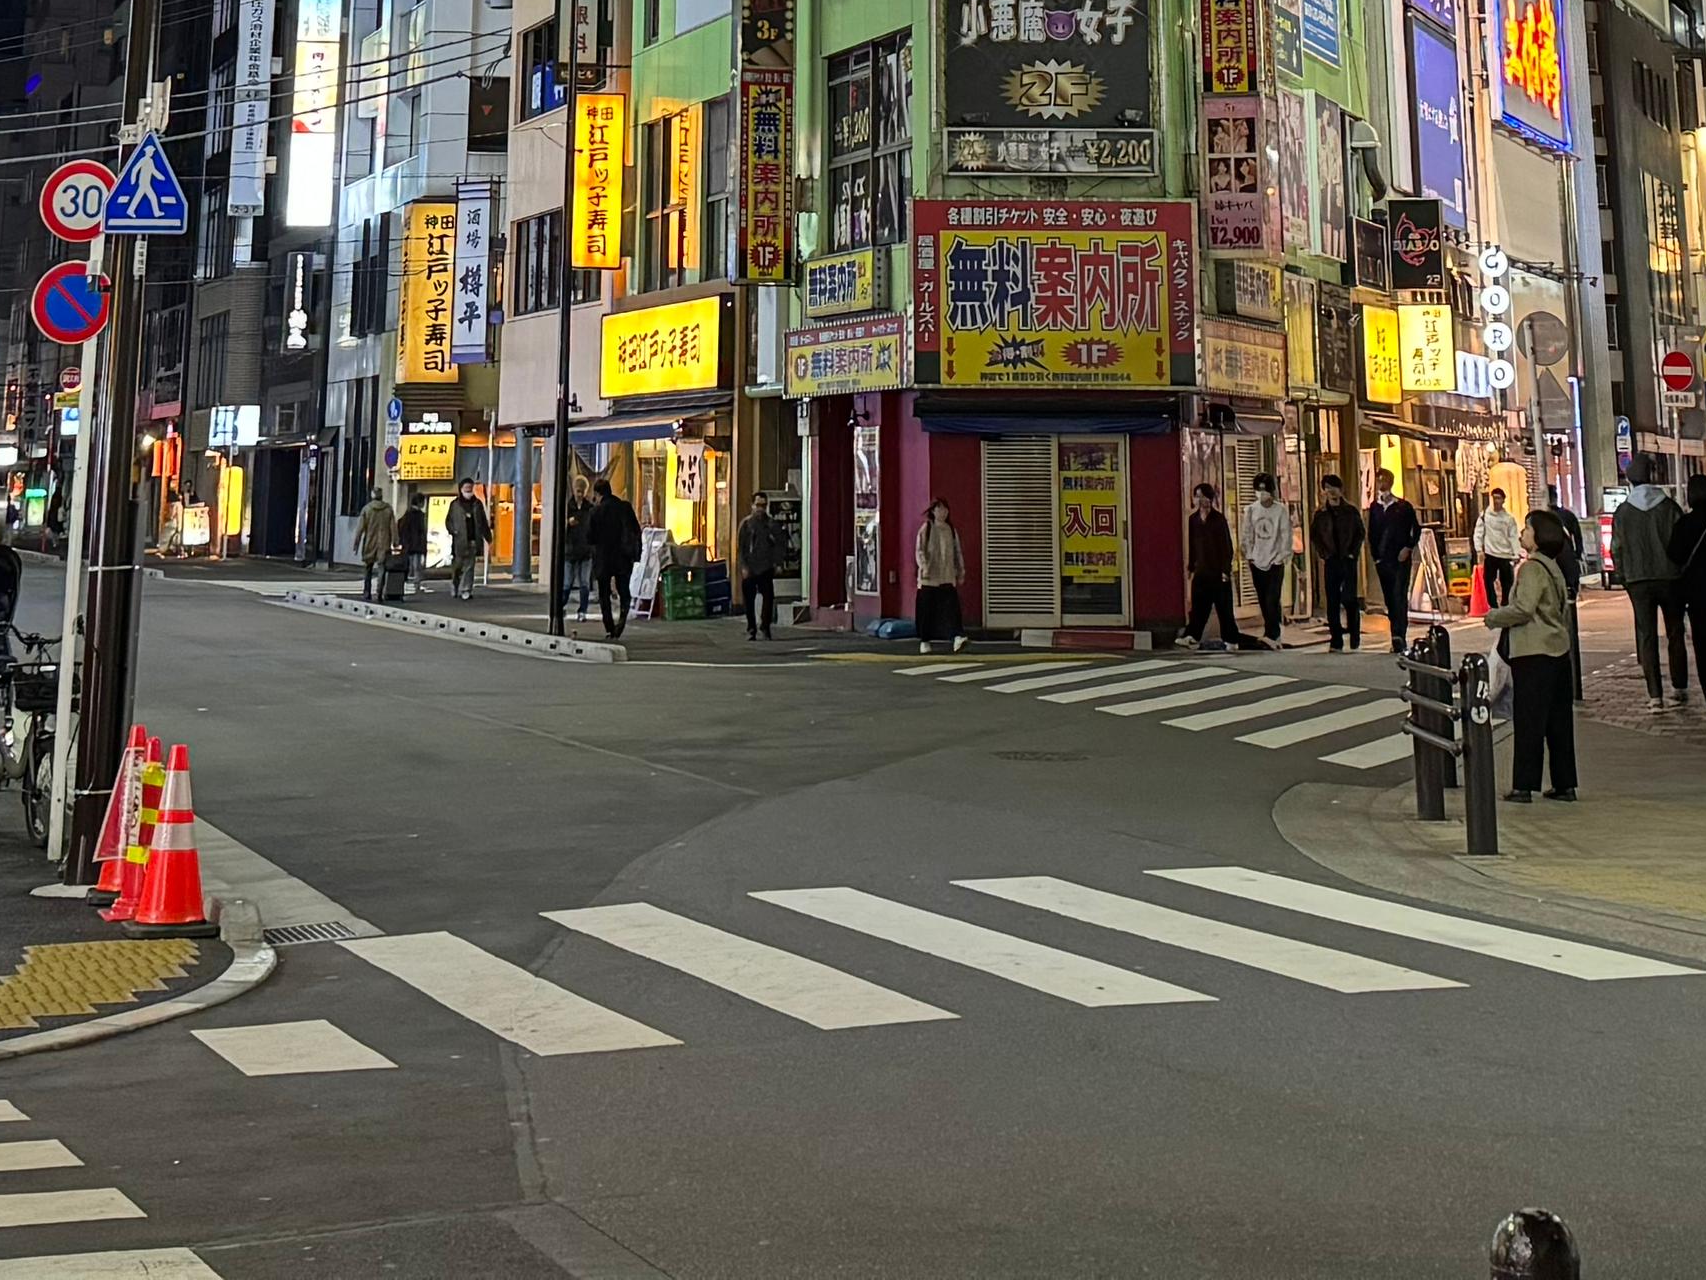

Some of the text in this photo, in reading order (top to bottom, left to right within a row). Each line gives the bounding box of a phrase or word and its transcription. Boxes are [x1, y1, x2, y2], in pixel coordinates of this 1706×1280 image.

[1018, 70, 1092, 107] 2F
[1221, 67, 1240, 84] 1F
[1084, 139, 1151, 167] ¥2,200
[587, 105, 613, 257] 神田 江戸ッ子寿司
[752, 111, 781, 238] 無料案内所
[59, 184, 103, 218] 30
[947, 207, 1039, 226] 各種割引チケット
[465, 208, 482, 249] 酒場
[1210, 226, 1261, 245] ¥2,900
[757, 246, 775, 266] 1F
[423, 214, 455, 373] 神田 江戸ッ子寿司
[945, 235, 1163, 337] 無料案内所
[1076, 344, 1109, 364] 1F
